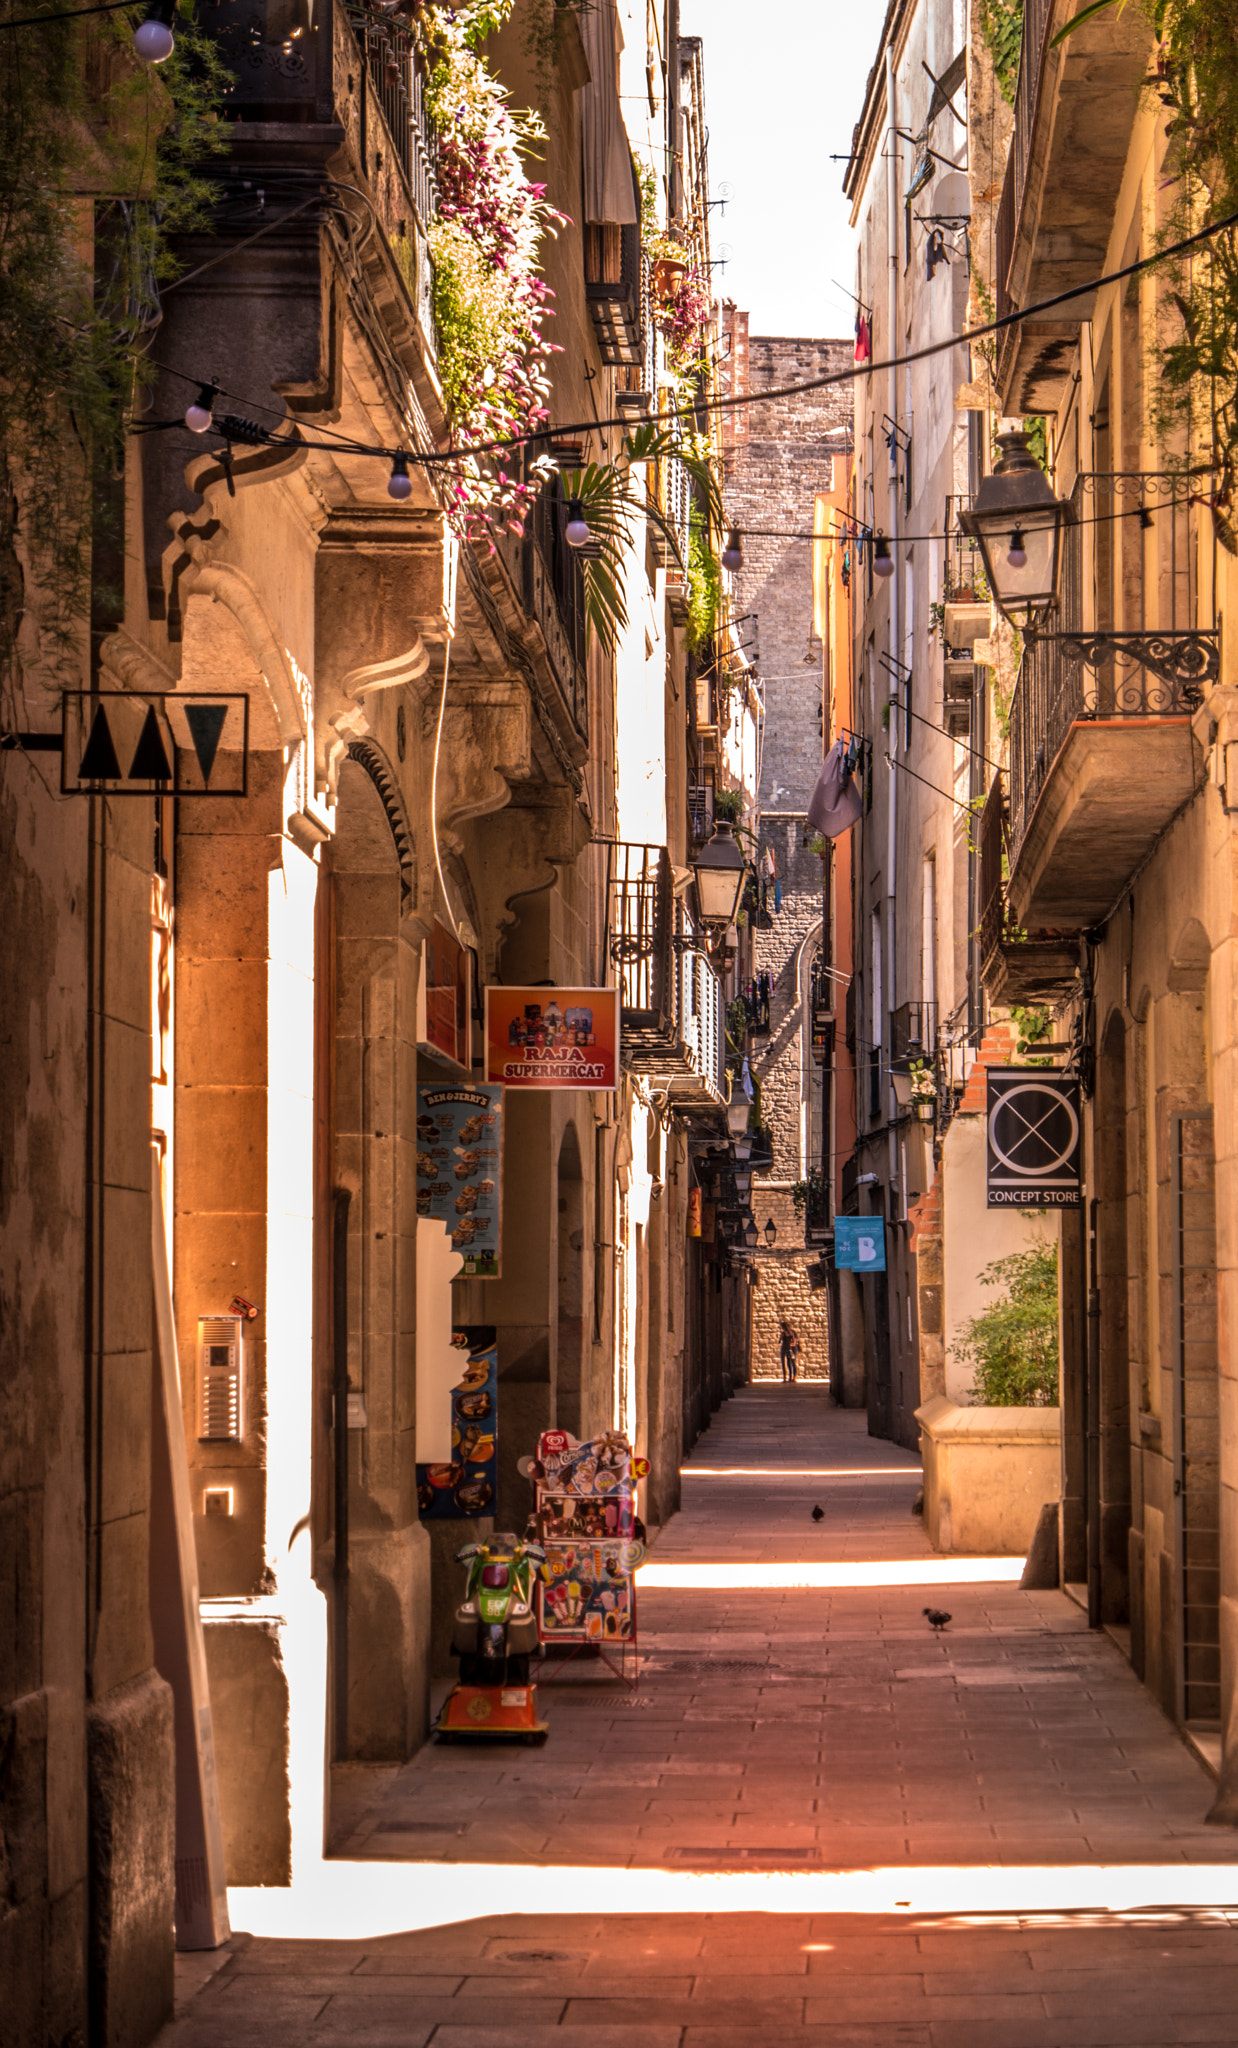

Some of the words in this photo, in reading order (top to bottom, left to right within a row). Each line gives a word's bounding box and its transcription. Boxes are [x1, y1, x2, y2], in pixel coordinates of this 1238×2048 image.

[524, 1047, 586, 1062] RAJA
[504, 1063, 605, 1079] SUPERMERCAT
[988, 1191, 1042, 1203] CONCEPT
[1043, 1191, 1079, 1203] STORE
[858, 1237, 877, 1262] B
